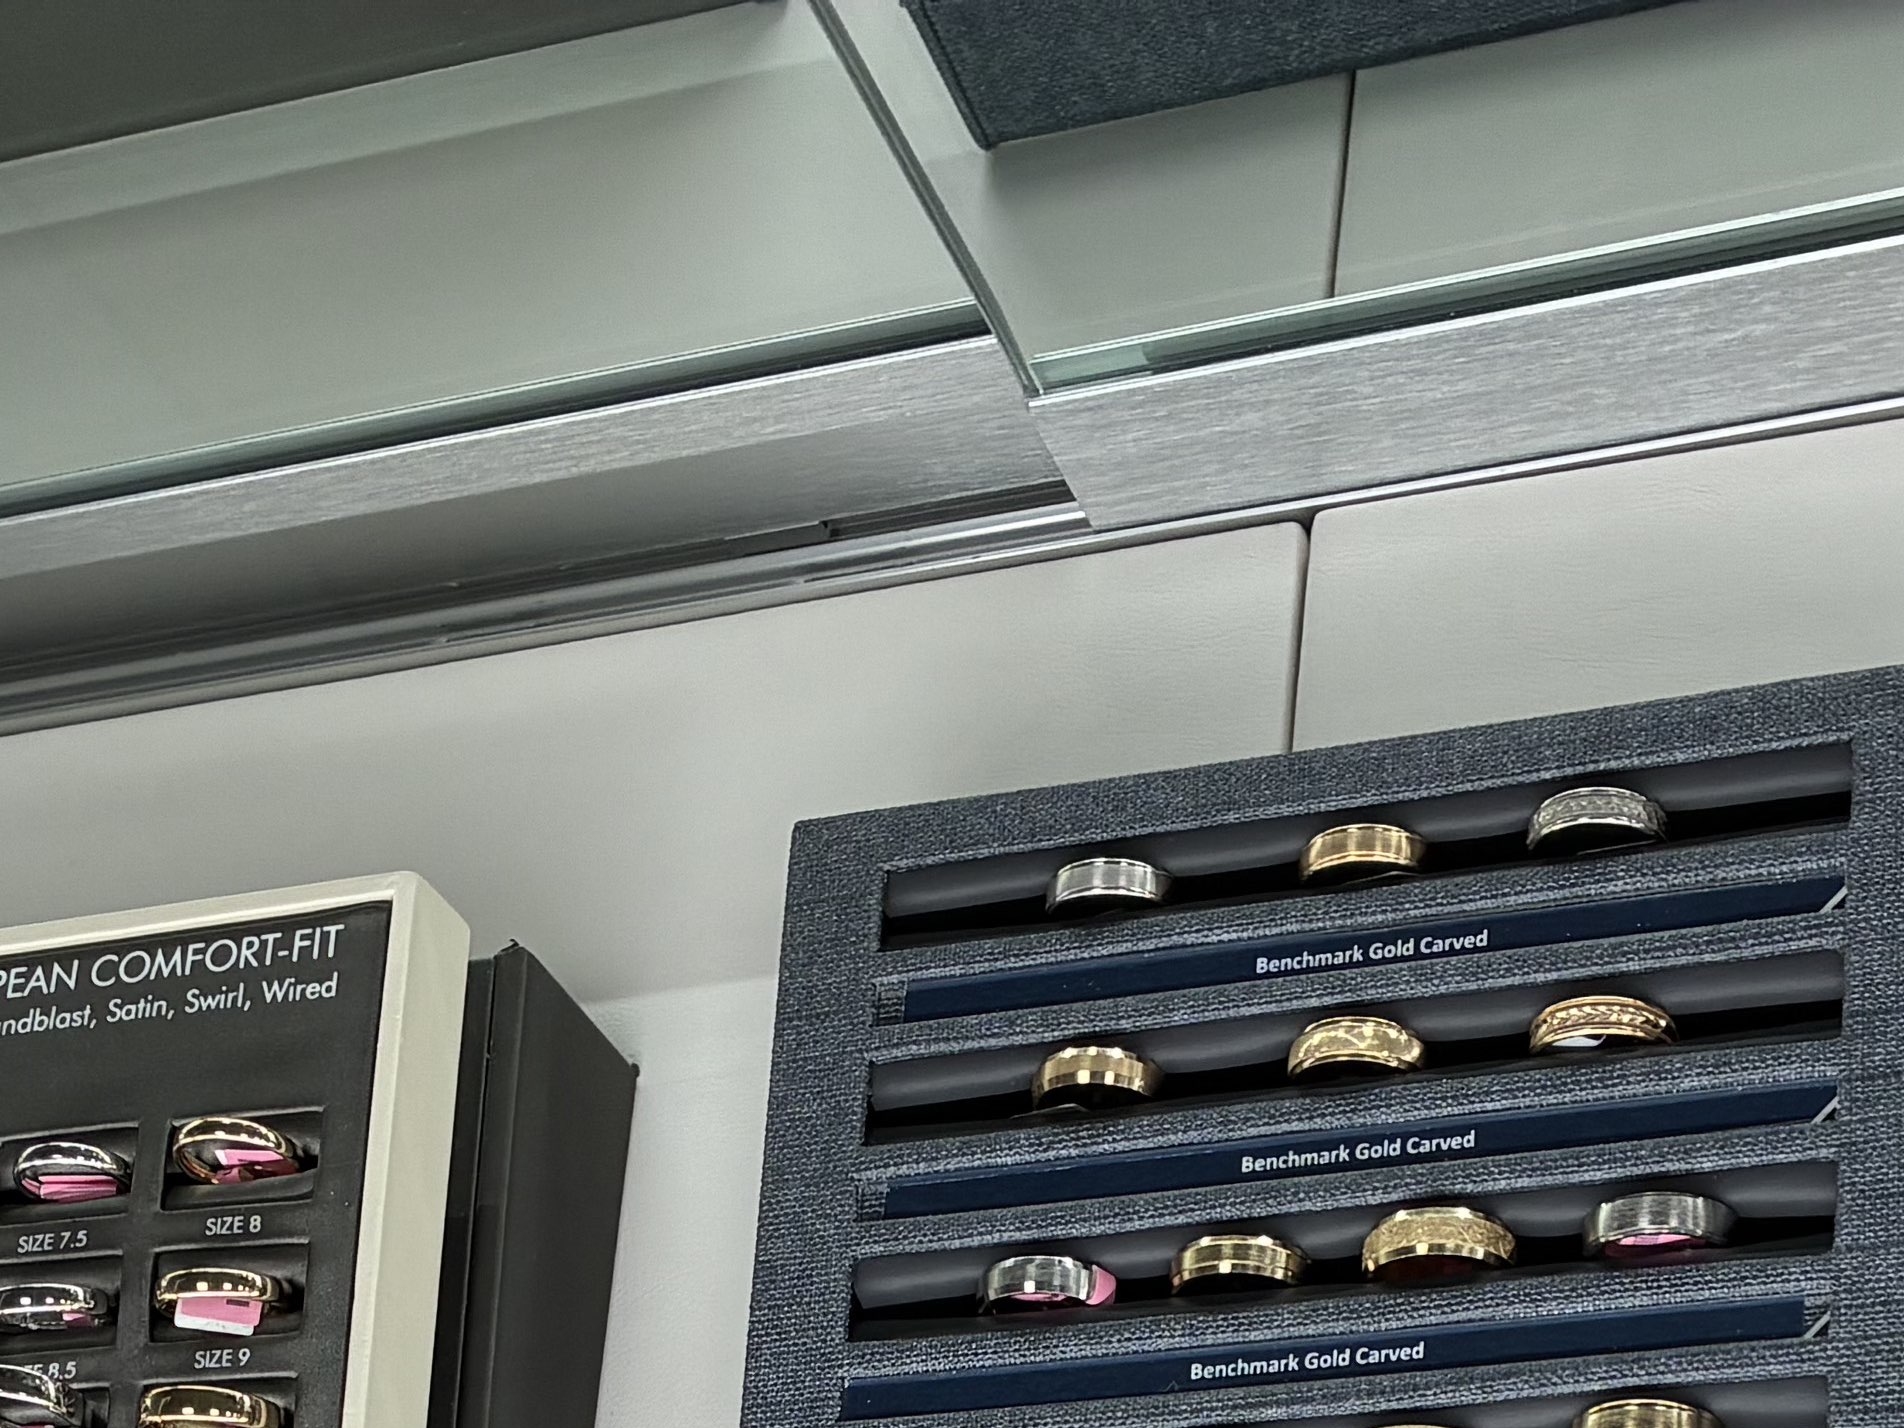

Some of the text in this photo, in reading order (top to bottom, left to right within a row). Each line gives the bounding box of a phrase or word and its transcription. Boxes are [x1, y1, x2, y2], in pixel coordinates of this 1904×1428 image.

[90, 924, 345, 988] COMFORT-FIT
[1255, 928, 1488, 975] Benchmark Gold Carved
[106, 994, 175, 1023] Satin,
[184, 982, 251, 1014] Swirl,
[261, 971, 338, 1004] Wired
[1240, 1129, 1476, 1174] Benchmark Gold Carved
[205, 1214, 262, 1236] SIZE 8
[1190, 1340, 1425, 1380] Benchmark Gold Carved
